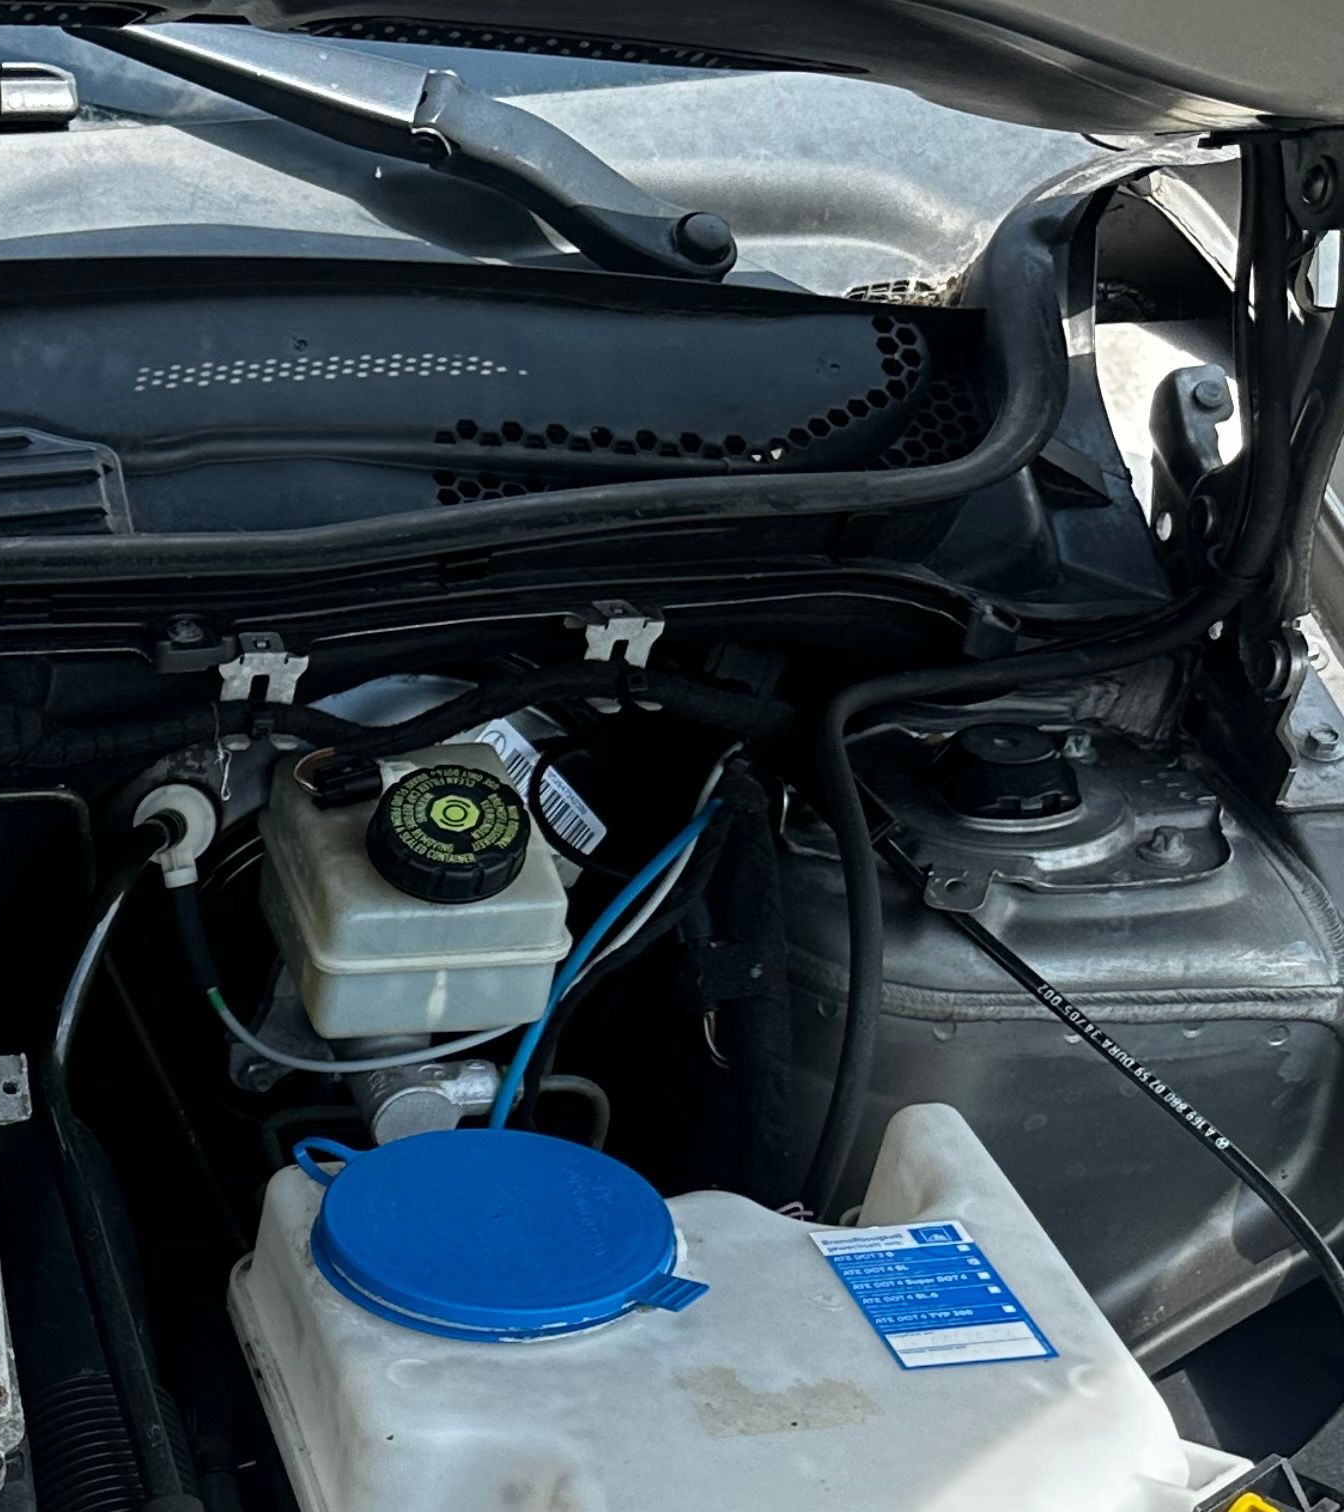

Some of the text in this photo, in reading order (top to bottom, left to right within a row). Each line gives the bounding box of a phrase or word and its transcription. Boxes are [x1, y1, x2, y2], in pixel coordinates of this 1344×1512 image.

[397, 831, 427, 855] SEALED
[424, 849, 475, 862] CONTAINER
[1101, 1038, 1135, 1068] DURA
[1134, 1067, 1151, 1082] 59
[1148, 1079, 1166, 1094] 02
[1185, 1111, 1206, 1129] 169
[1205, 1126, 1217, 1137] A
[904, 1277, 935, 1285] Super
